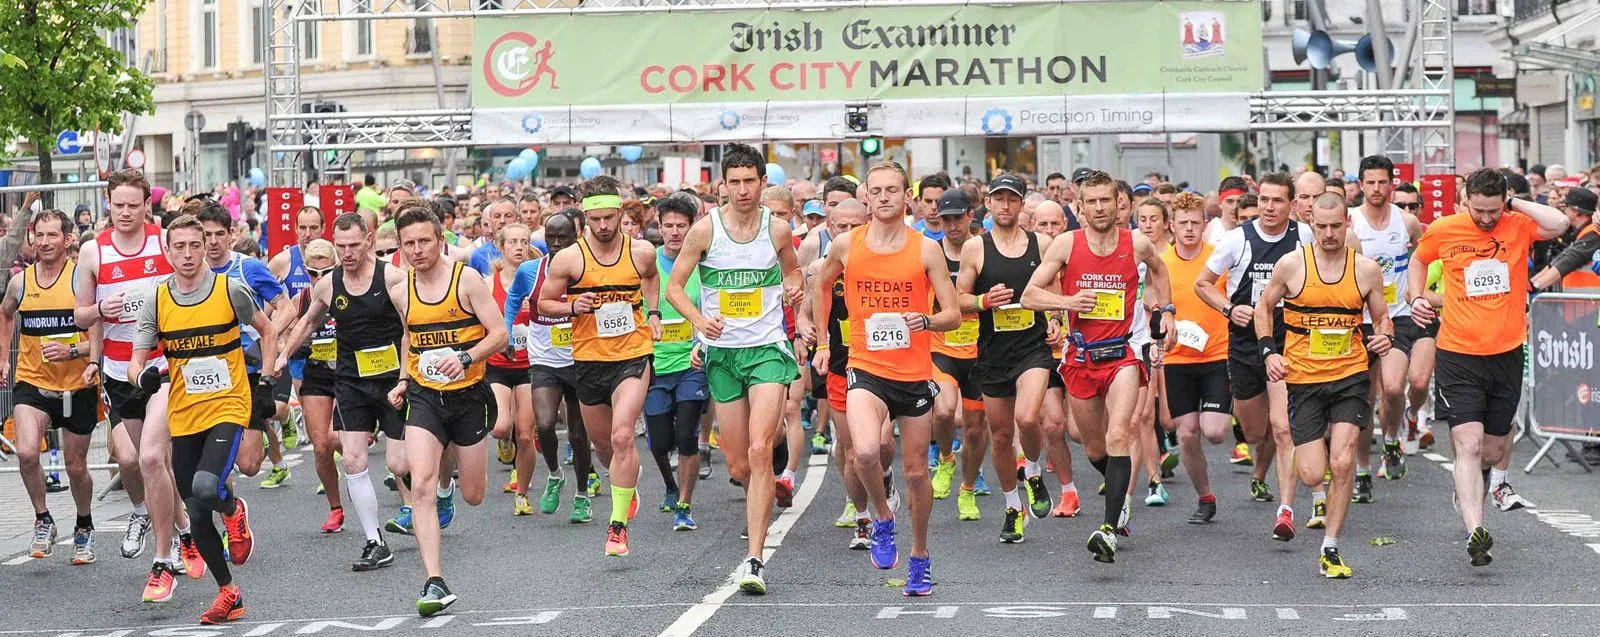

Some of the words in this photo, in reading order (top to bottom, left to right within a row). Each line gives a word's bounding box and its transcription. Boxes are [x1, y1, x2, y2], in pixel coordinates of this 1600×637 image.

[729, 20, 823, 53] Irish
[842, 16, 1017, 50] Examiner
[640, 62, 756, 94] CORK
[769, 60, 862, 91] CITY
[869, 54, 1107, 88] MARATHON
[1020, 109, 1095, 125] Precision
[1099, 107, 1153, 125] Timing
[1432, 179, 1443, 219] CORK
[281, 192, 291, 231] CORK
[1253, 263, 1274, 271] CORK
[717, 271, 768, 286] RAHENY
[1081, 273, 1104, 281] CORK
[1473, 275, 1501, 287] 6293
[856, 281, 913, 292] FREDA'S
[1076, 280, 1092, 288] FIRE
[1093, 281, 1127, 290] BRIGADE
[729, 301, 751, 309] Cillian
[861, 296, 909, 308] FLYERS
[603, 316, 629, 329] 6582
[1301, 316, 1357, 327] LEEVALE
[418, 331, 459, 346] LEEVALE
[872, 330, 904, 342] 6216
[1537, 330, 1594, 370] Irish
[192, 374, 220, 385] 6251
